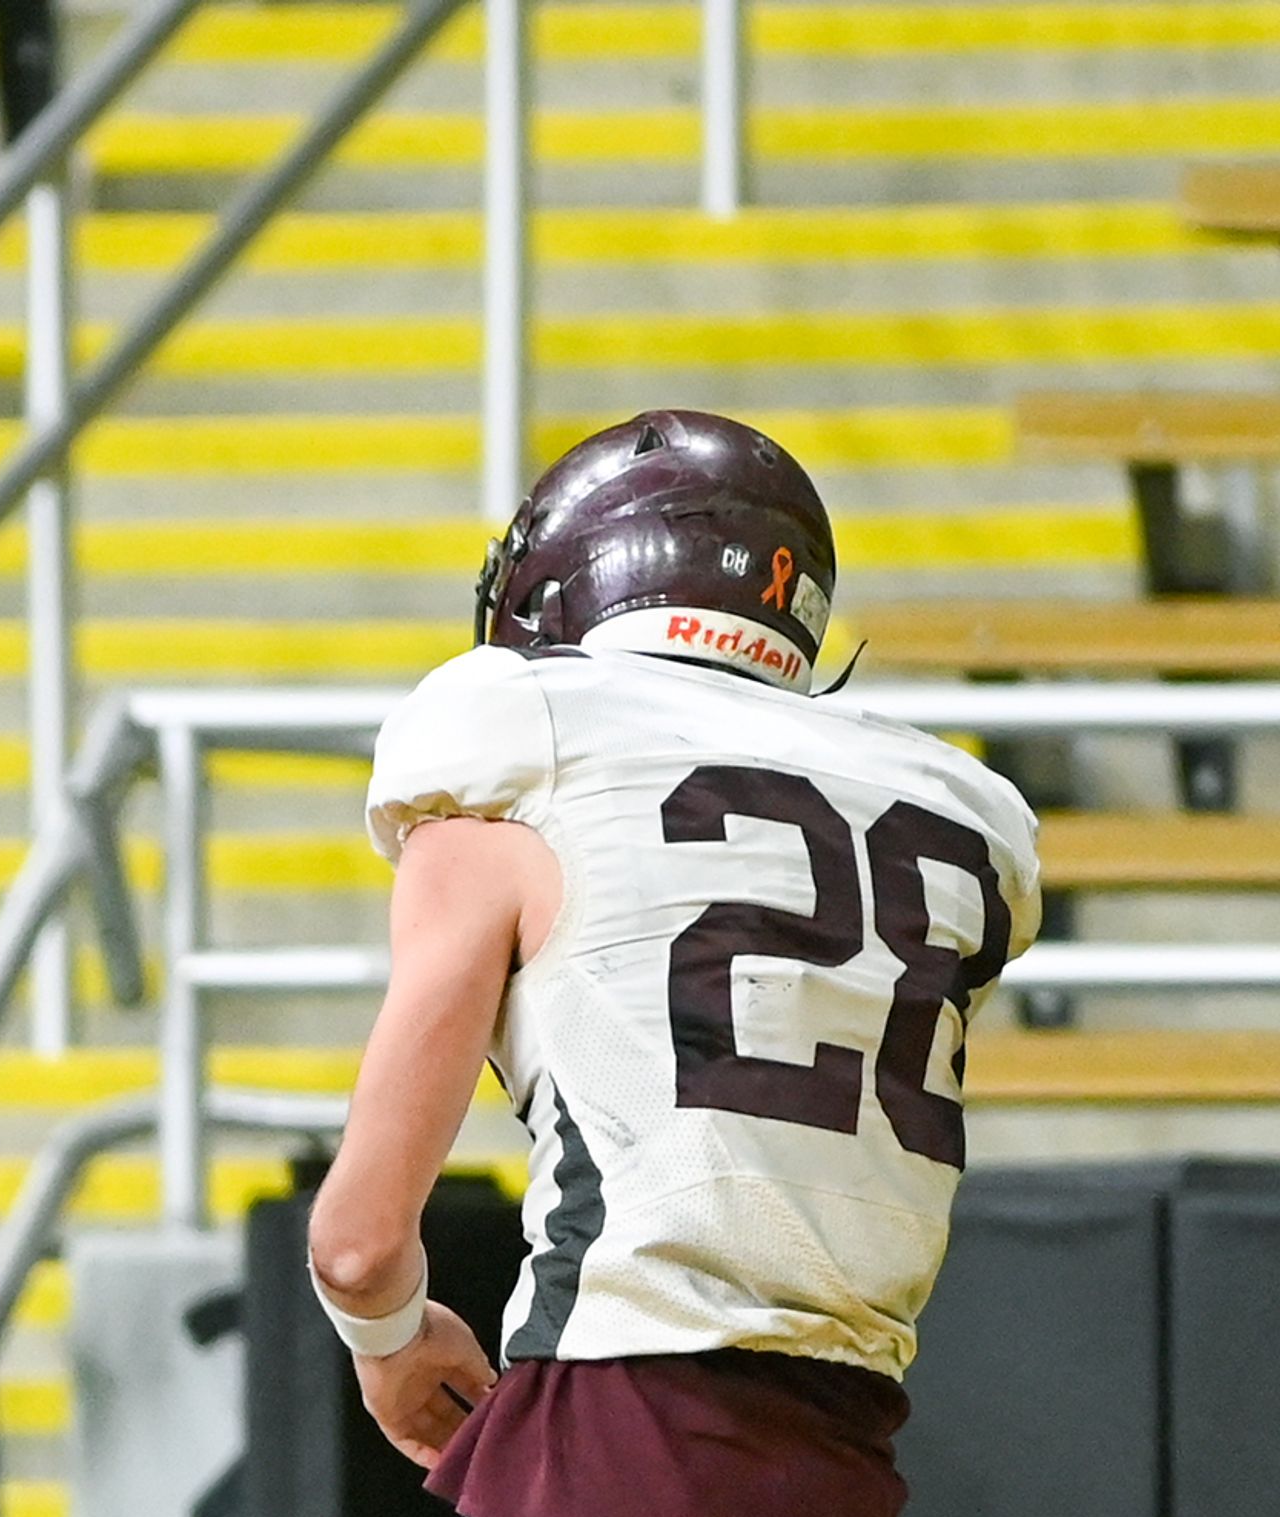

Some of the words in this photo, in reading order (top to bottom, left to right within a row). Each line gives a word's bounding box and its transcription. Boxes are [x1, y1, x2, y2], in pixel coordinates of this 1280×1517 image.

[721, 547, 748, 576] DH
[667, 614, 802, 681] Riddell
[660, 765, 1012, 1173] 28
